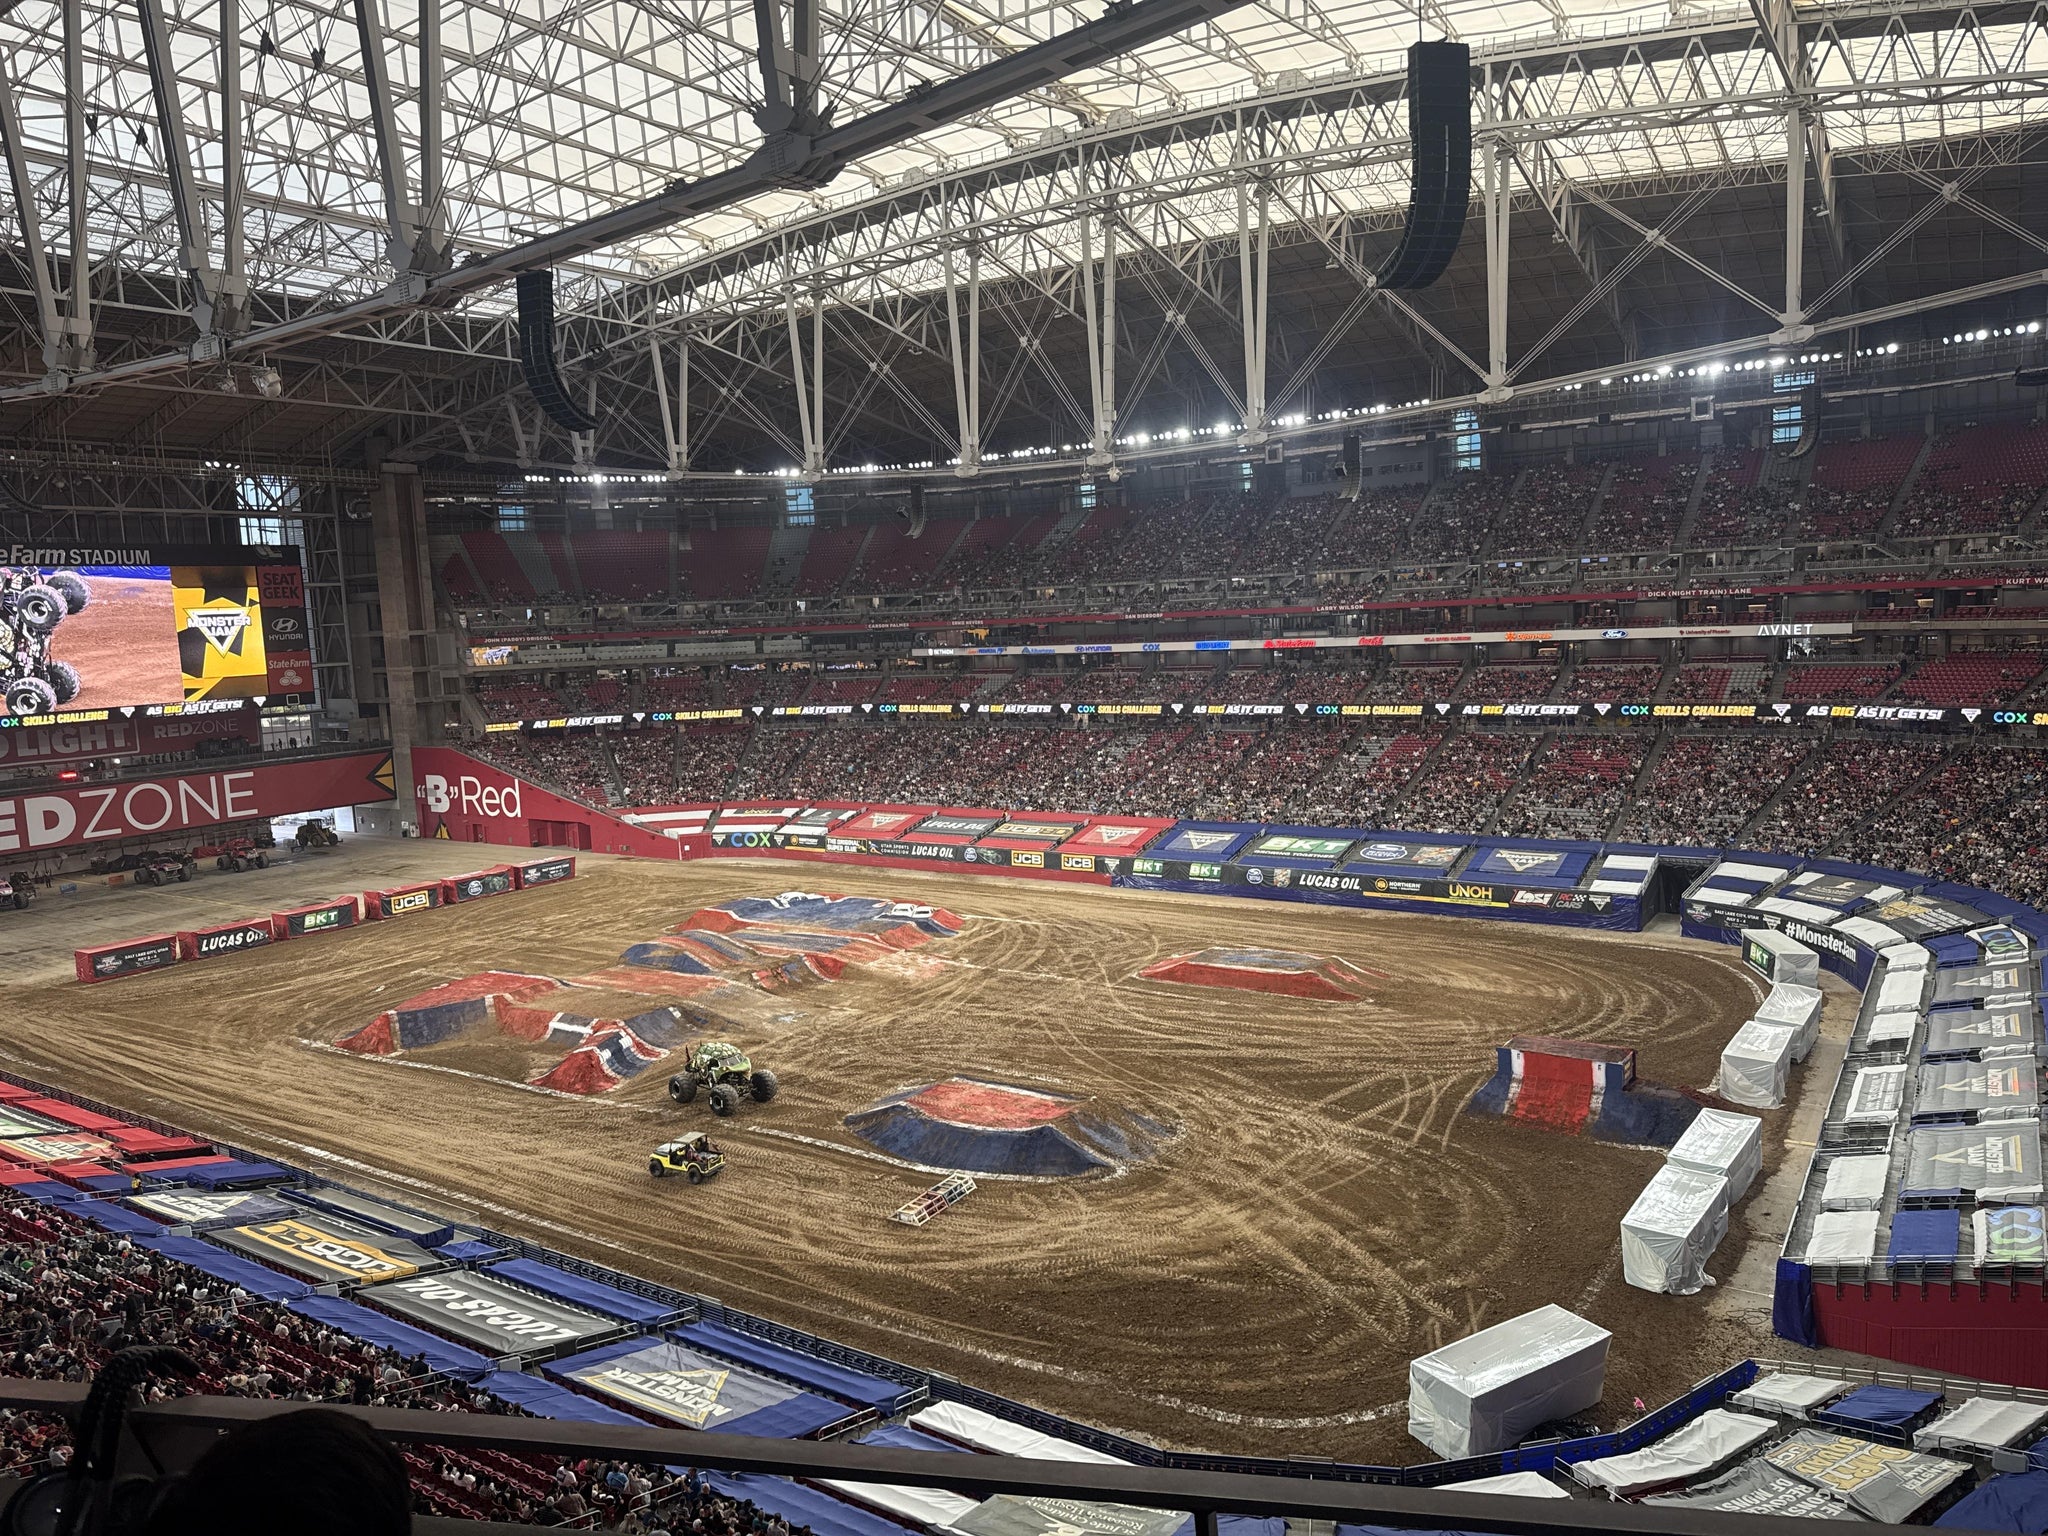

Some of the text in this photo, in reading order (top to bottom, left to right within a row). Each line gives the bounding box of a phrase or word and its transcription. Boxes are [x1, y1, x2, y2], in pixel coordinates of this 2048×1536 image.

[70, 549, 151, 565] STADIUM
[263, 573, 297, 586] SEAT
[263, 586, 299, 600] GEEK
[268, 633, 304, 641] HYUNDAI
[1757, 624, 1814, 636] AVNET
[146, 700, 244, 716] AS BIG AS IT GETS!
[653, 708, 743, 721] COX SKILLS CHALLENGE
[1077, 705, 1162, 714] COX SKILLS CHALLENGE
[1316, 705, 1423, 715] COX SKILLS CHALLENGE
[1462, 705, 1481, 714] AS
[1505, 705, 1523, 715] AS
[1524, 705, 1540, 715] IT
[1620, 705, 1757, 717] COX SKILLS CHALLENGE
[1806, 705, 1946, 720] AS BIG AS IT GETS!
[0, 710, 109, 727] OX SKILLS CHALLENGE
[1993, 711, 2028, 723] COX
[154, 718, 239, 739] REDZONE
[15, 723, 130, 757] LIGHT
[730, 832, 772, 848] COX
[1261, 837, 1348, 853] BKT
[911, 845, 938, 857] LUCAS
[938, 847, 955, 859] OIL
[1013, 853, 1043, 867] JCB
[1063, 856, 1094, 869] JCB
[1133, 860, 1164, 874] BKT
[1189, 863, 1222, 878] BKT
[1298, 873, 1362, 892] LUCAS OIL
[1388, 880, 1421, 889] NORTHERN
[1448, 883, 1493, 900] UNOH
[1558, 893, 1573, 901] RC
[394, 895, 427, 911] JCB
[1555, 900, 1583, 909] CARS
[303, 909, 339, 928] BKT
[200, 931, 244, 953] LUCAS
[1784, 920, 1857, 963] #MonsterJam
[1750, 941, 1769, 967] BKT
[394, 1276, 582, 1341] LUCAS OIL
[601, 1366, 732, 1418] MONSTER
[1793, 1436, 1868, 1476] SQUAD
[1829, 1444, 1913, 1493] DIRT
[1769, 1478, 1795, 1493] OF
[1097, 1521, 1122, 1534] Jude
